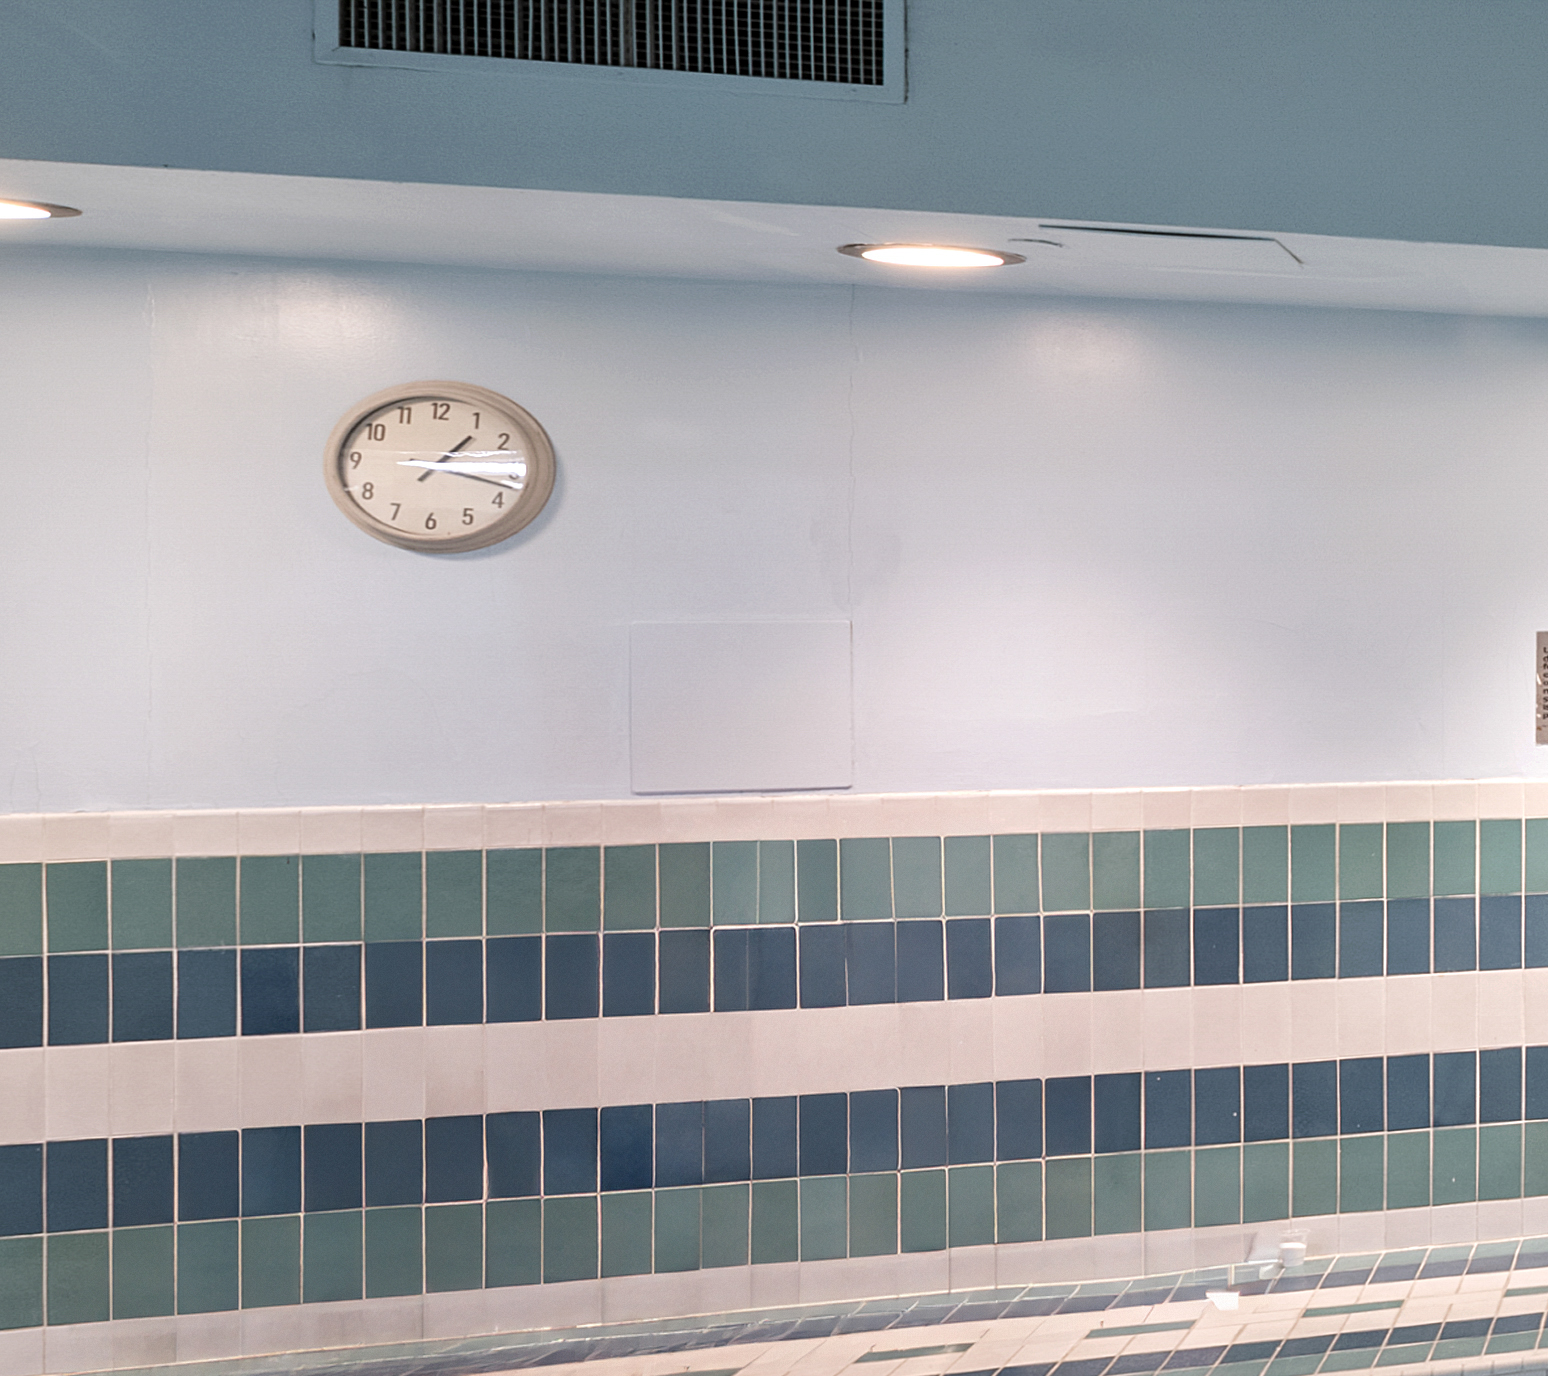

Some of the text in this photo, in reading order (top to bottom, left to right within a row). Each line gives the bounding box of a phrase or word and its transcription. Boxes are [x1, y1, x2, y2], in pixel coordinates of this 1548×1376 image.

[398, 406, 412, 425] 11
[432, 403, 451, 421] 12
[472, 412, 481, 429] 1
[367, 423, 386, 441] 10
[497, 433, 510, 451] 2
[350, 451, 362, 469] 9
[362, 482, 374, 500] 8
[491, 492, 505, 508] 4
[390, 503, 401, 521] 7
[425, 512, 437, 530] 6
[462, 508, 474, 526] 5
